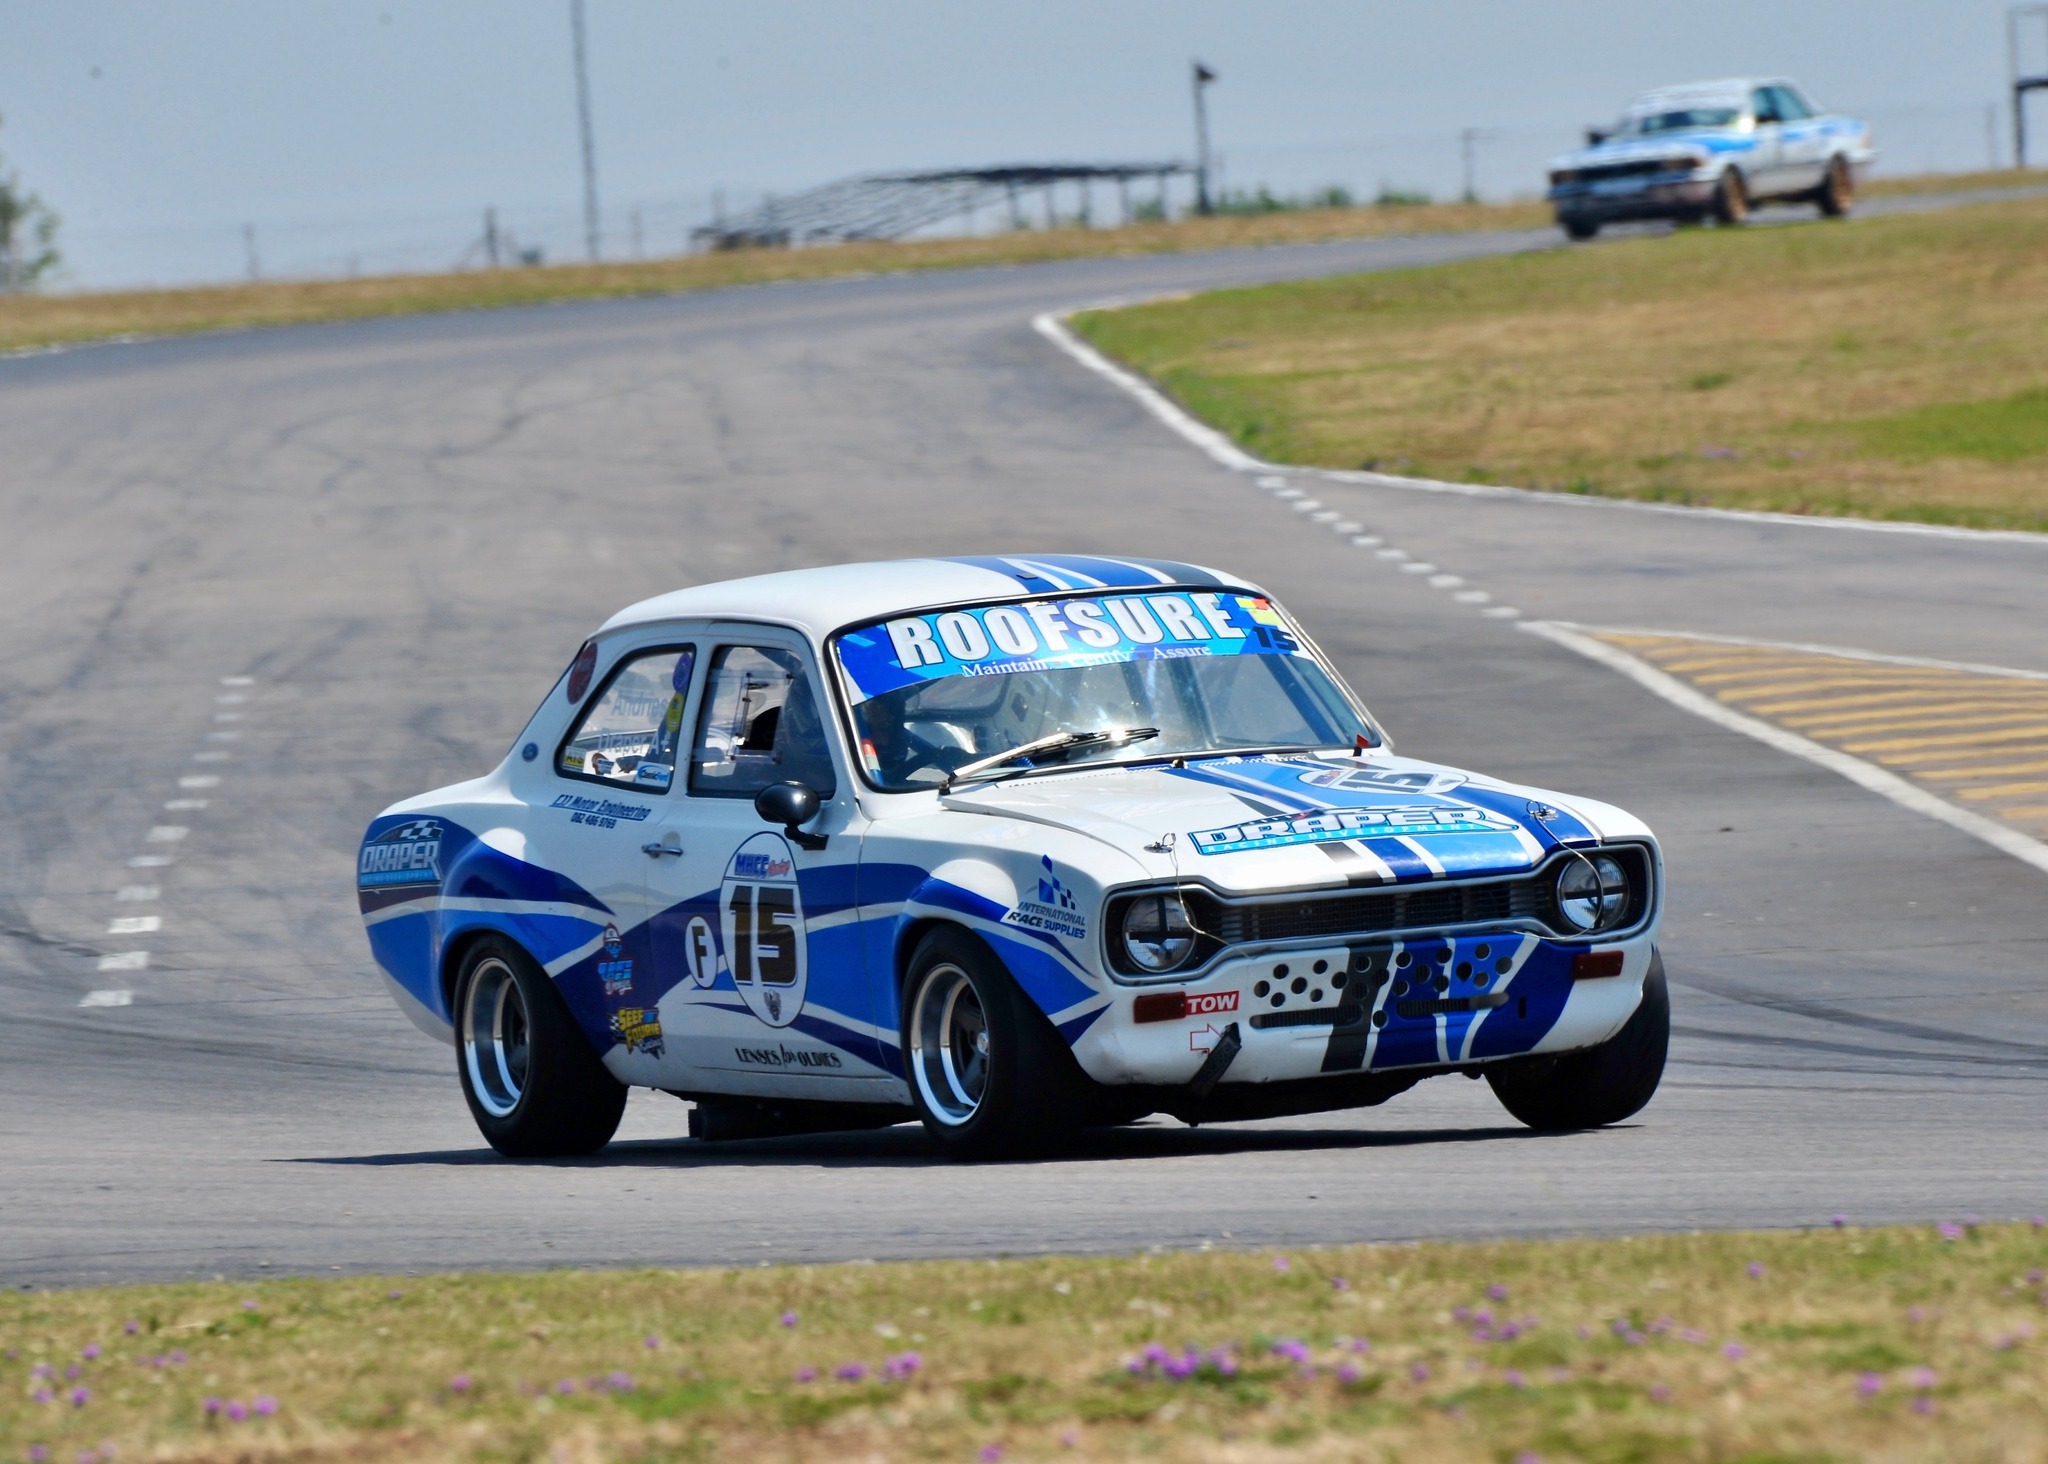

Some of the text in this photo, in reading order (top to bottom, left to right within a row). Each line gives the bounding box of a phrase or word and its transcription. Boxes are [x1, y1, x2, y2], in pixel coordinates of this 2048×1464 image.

[886, 593, 1247, 669] ROOFSURE
[1252, 626, 1299, 651] 15
[961, 659, 1047, 678] Maintain
[1150, 645, 1213, 660] Assure
[598, 728, 644, 755] Draper
[1338, 770, 1438, 794] 15
[571, 796, 599, 810] Motor
[597, 799, 652, 818] Engineering
[1193, 809, 1514, 846] DRAPER
[1207, 824, 1476, 852] RACING DEVELOPMENT
[361, 841, 441, 879] DRAPER
[1007, 911, 1086, 939] RACE SUPPLIES
[1017, 901, 1086, 926] INTERNATIONAL
[729, 885, 798, 988] 15
[691, 926, 708, 979] F
[1187, 994, 1237, 1013] TOW
